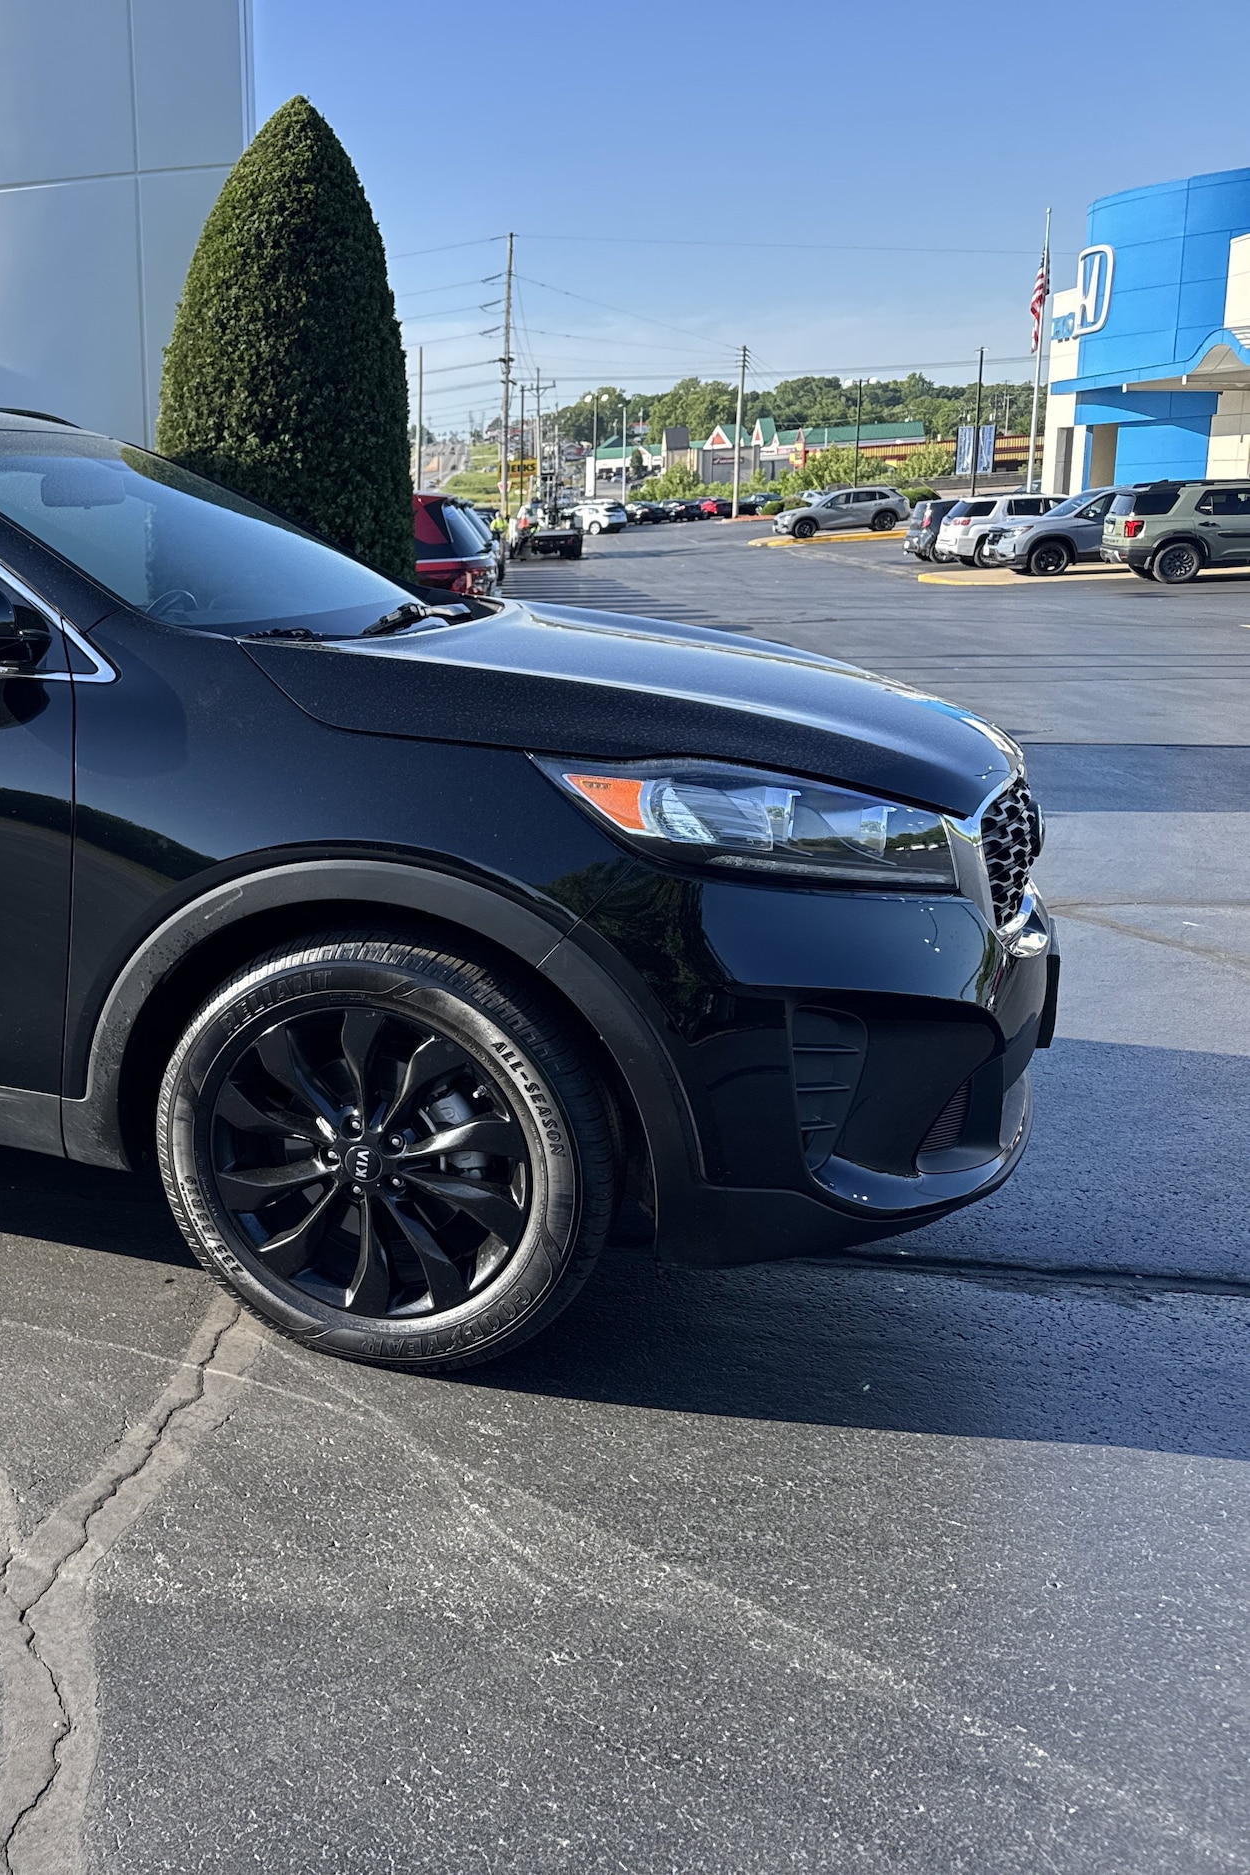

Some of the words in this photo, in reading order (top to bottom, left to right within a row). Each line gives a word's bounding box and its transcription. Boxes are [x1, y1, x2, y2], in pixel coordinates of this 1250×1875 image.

[218, 971, 332, 1036] RELIANT
[491, 1042, 566, 1157] ALL-SEASON
[355, 1150, 370, 1178] KIA
[184, 1175, 245, 1275] 235/55R19
[362, 1285, 532, 1357] GOODYEAR
